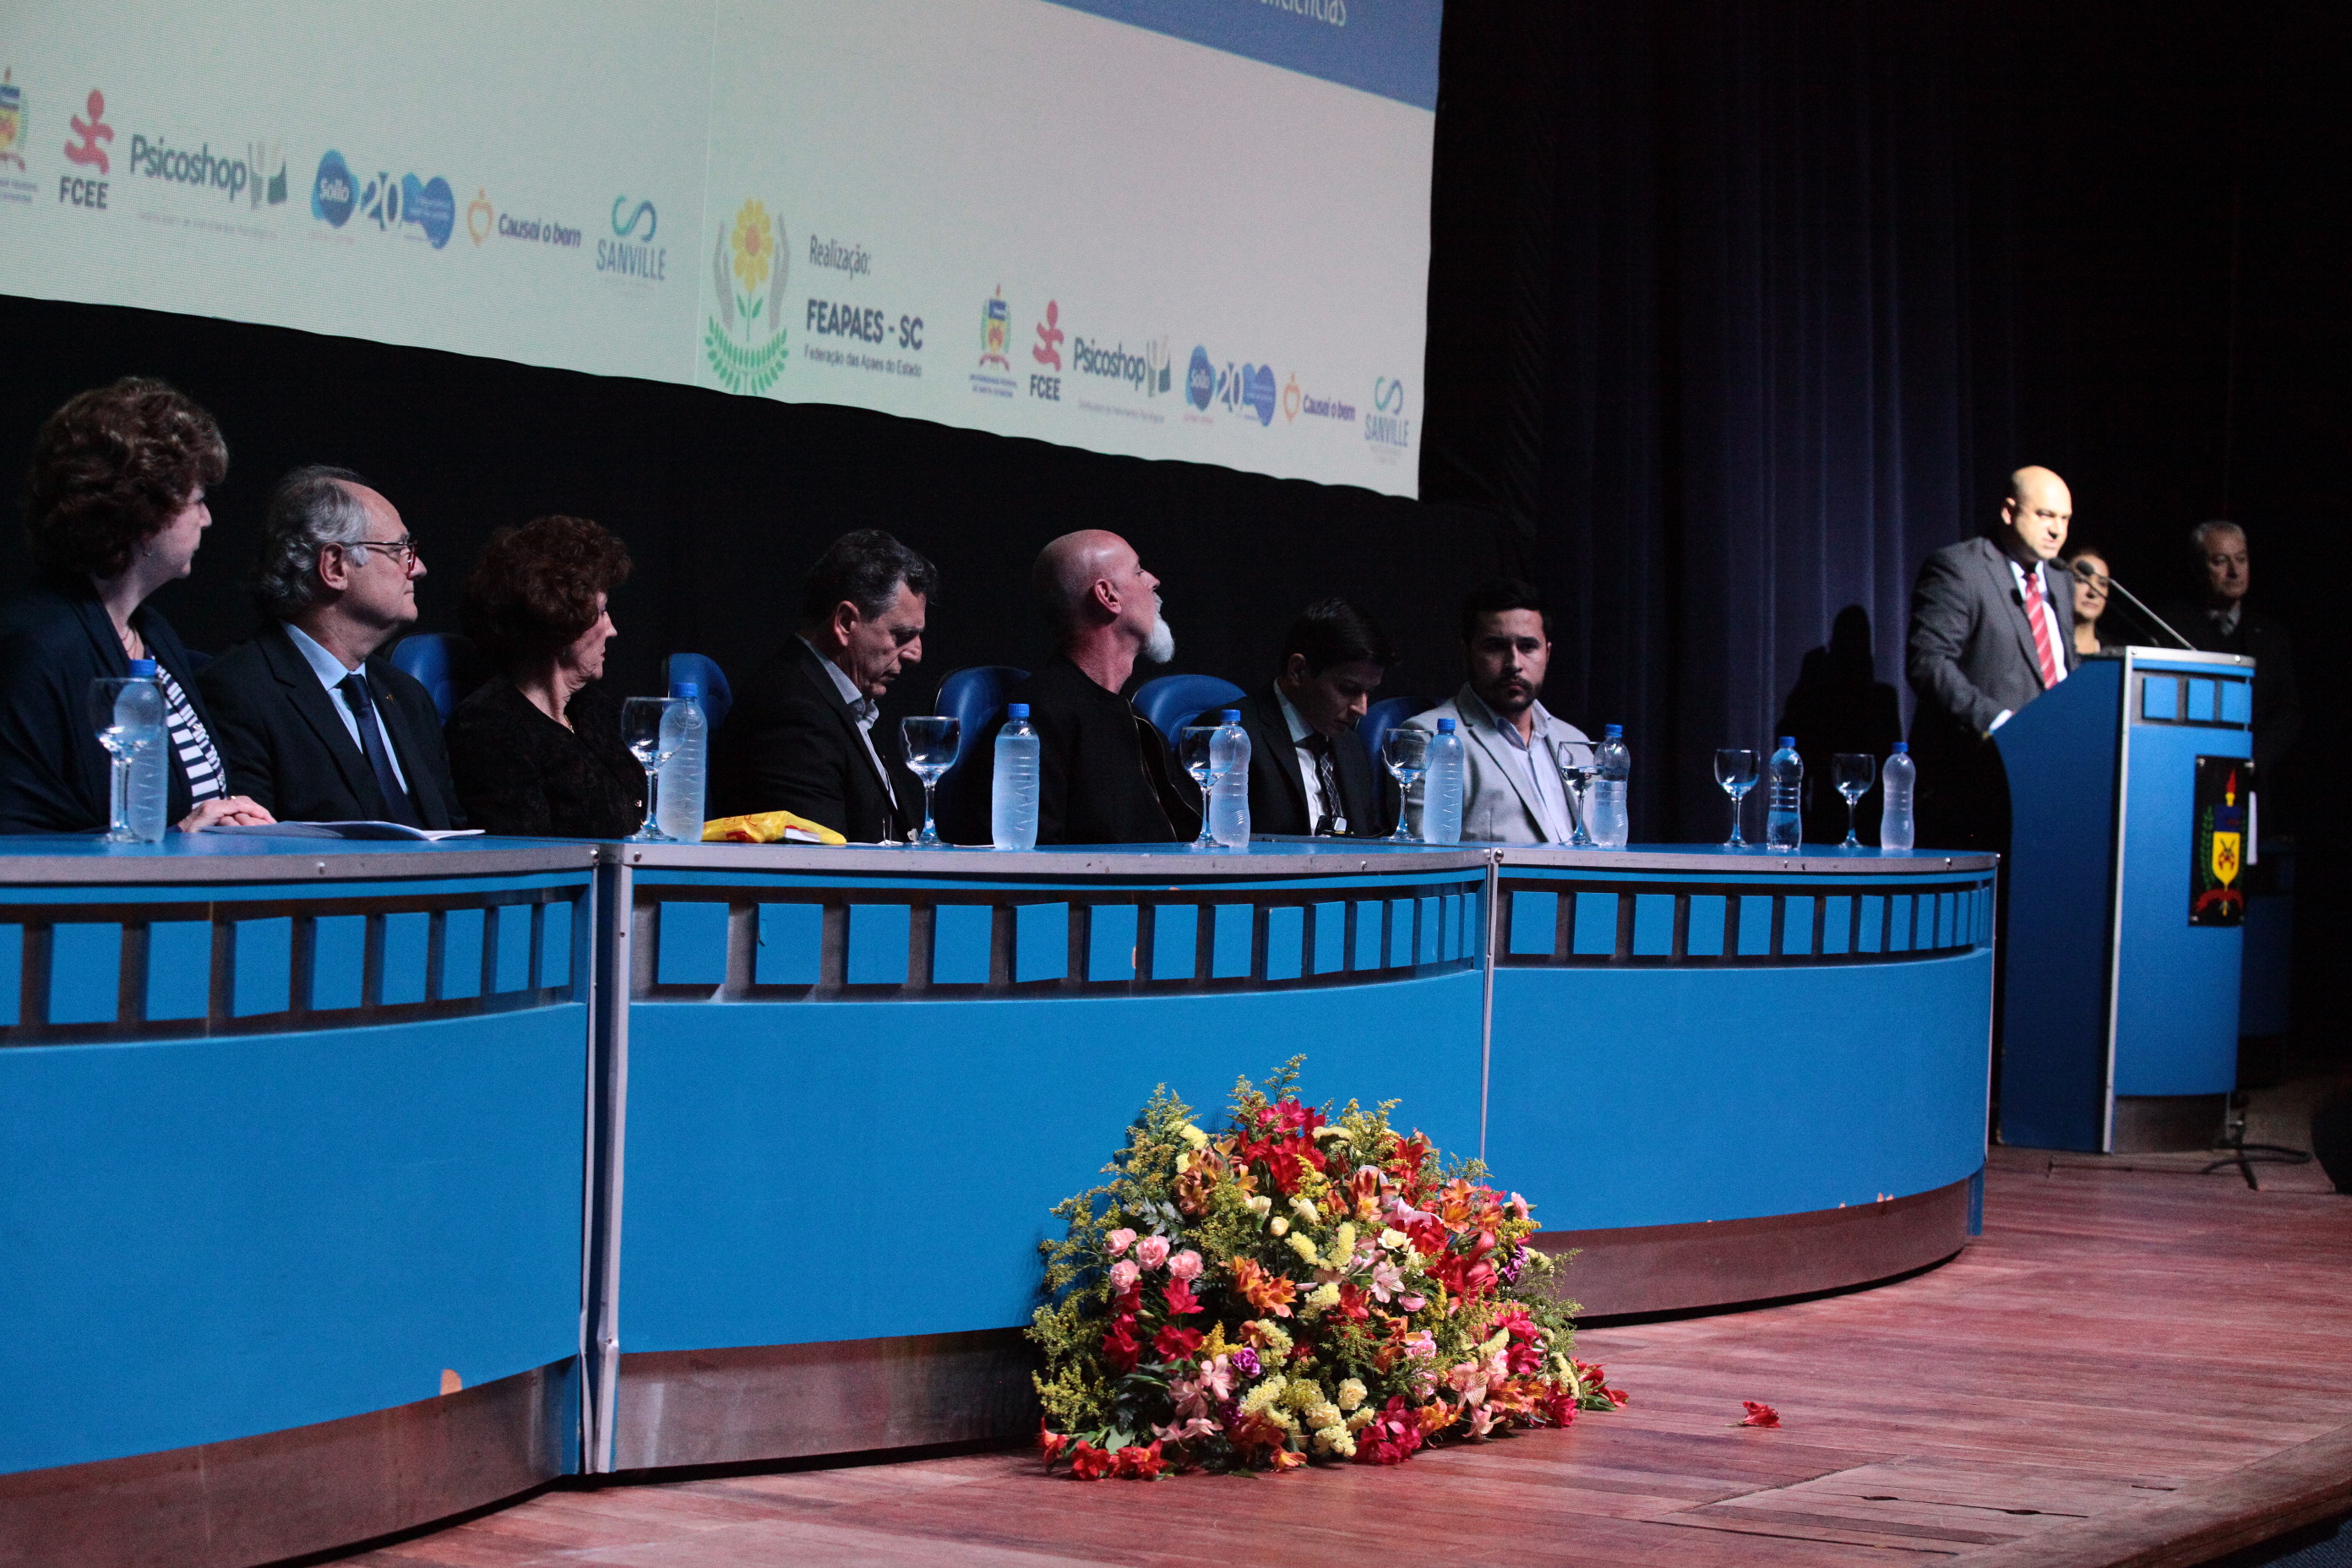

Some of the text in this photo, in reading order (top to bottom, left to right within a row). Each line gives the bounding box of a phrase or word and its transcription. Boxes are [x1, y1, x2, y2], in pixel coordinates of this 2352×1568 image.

[129, 133, 247, 203] Psicoshop
[59, 175, 109, 210] FCEE
[498, 213, 582, 248] Causei o bem
[596, 238, 667, 281] SANVILLE
[806, 298, 884, 344] FEAPAES
[899, 314, 924, 351] SC
[1073, 337, 1146, 391] Psicoshop
[1029, 374, 1061, 402] FCEE
[1364, 413, 1409, 448] SANVILLE
